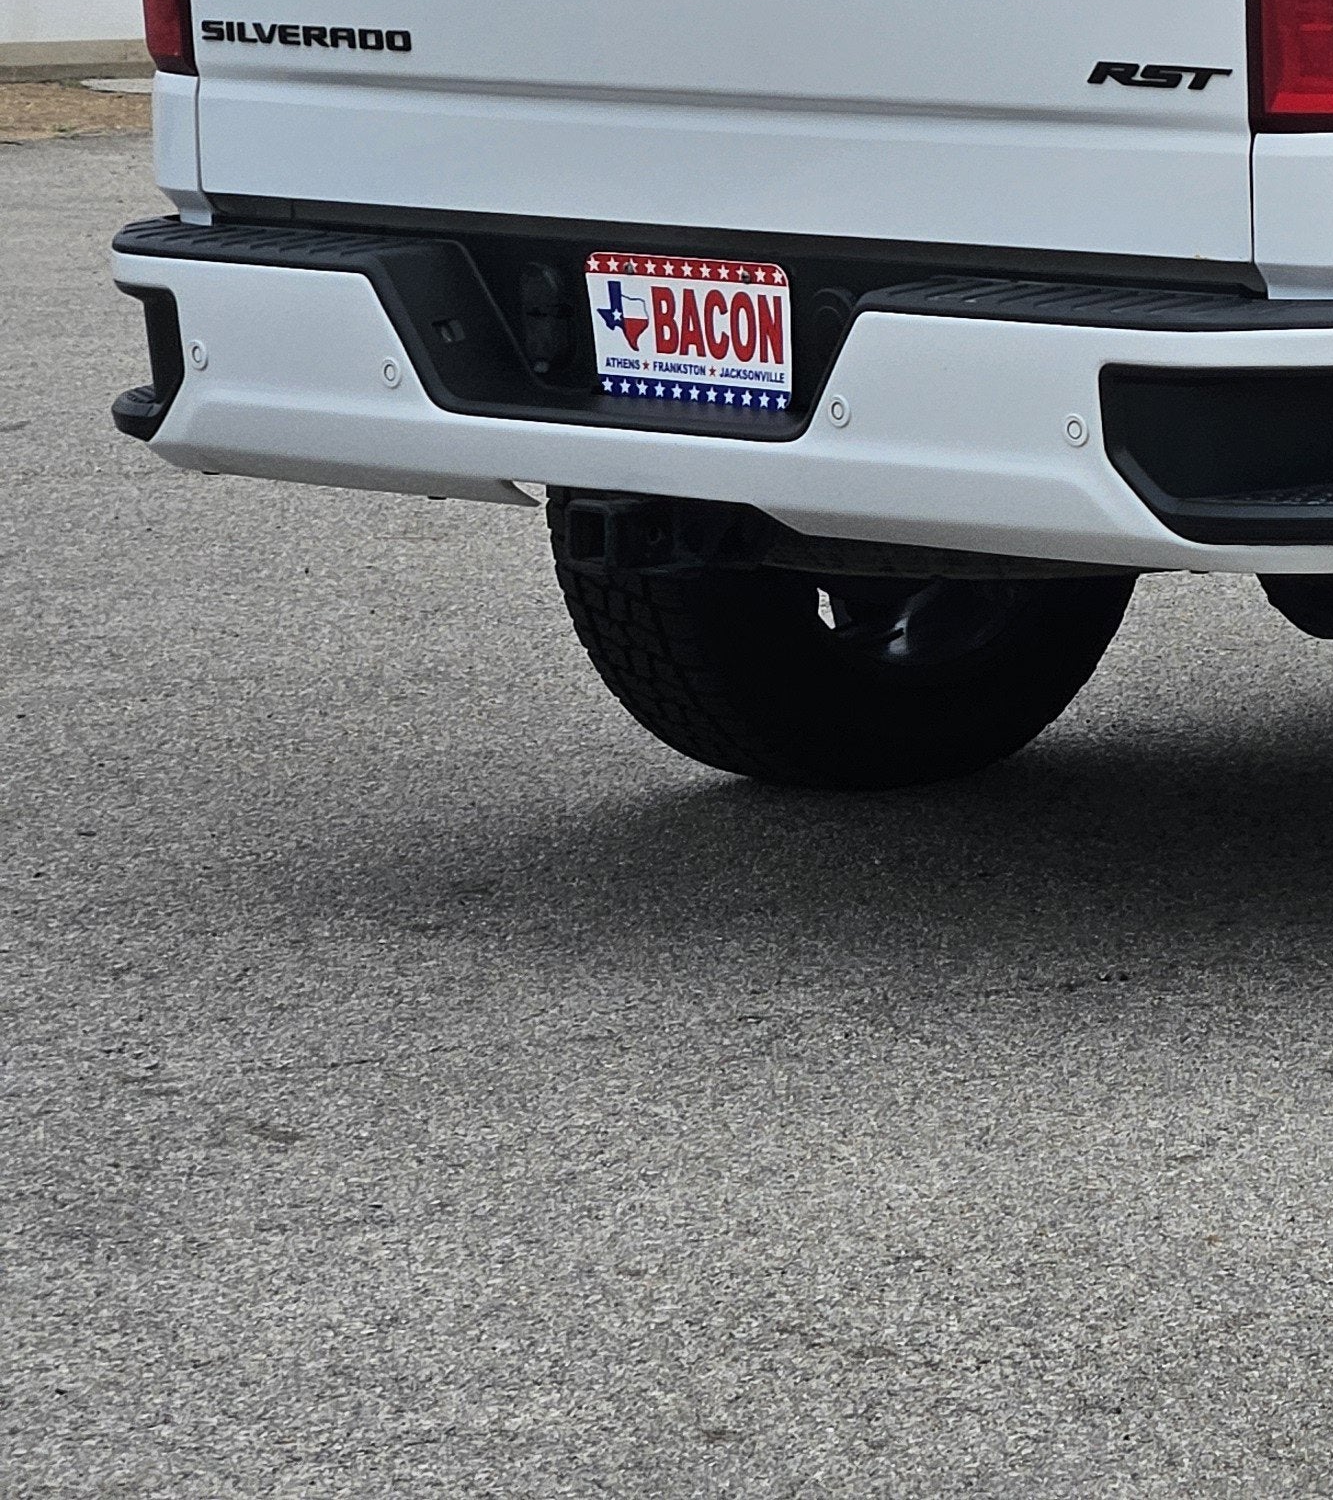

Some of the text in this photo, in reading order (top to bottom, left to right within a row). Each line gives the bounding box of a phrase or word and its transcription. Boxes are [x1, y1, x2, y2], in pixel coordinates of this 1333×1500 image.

[201, 20, 412, 51] SILVERADO
[1087, 61, 1233, 90] RST
[651, 286, 784, 364] BACON
[605, 357, 785, 384] ATHENS FRANKSTON JACKSONVILLE
